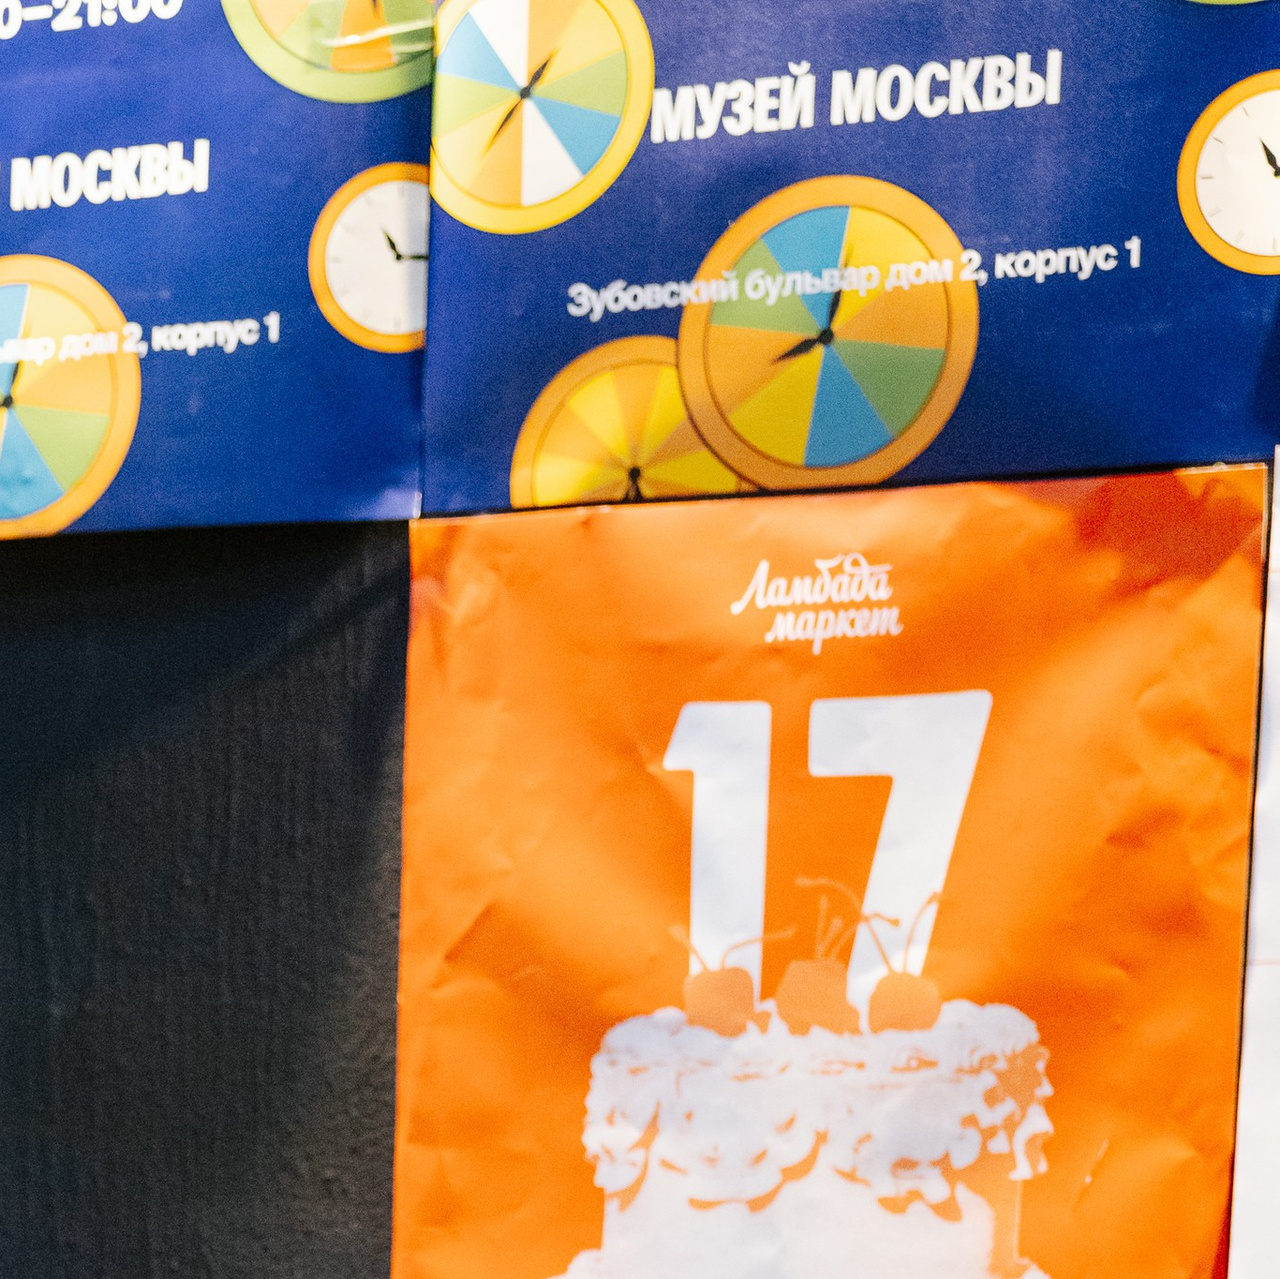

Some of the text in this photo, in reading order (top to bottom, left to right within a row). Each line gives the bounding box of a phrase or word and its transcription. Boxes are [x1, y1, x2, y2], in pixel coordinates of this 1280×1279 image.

[650, 48, 1063, 143] МУЗЕЙ МОСКВЫ
[9, 138, 210, 211] МОСКВЫ
[567, 236, 1143, 322] Зубовский бульвар дом 2, корпус 1
[122, 322, 149, 358] 2,
[152, 317, 260, 357] корпус
[263, 311, 282, 344] 1
[730, 552, 893, 615] Ламбада
[764, 605, 904, 656] маркет
[662, 689, 993, 1016] 17
